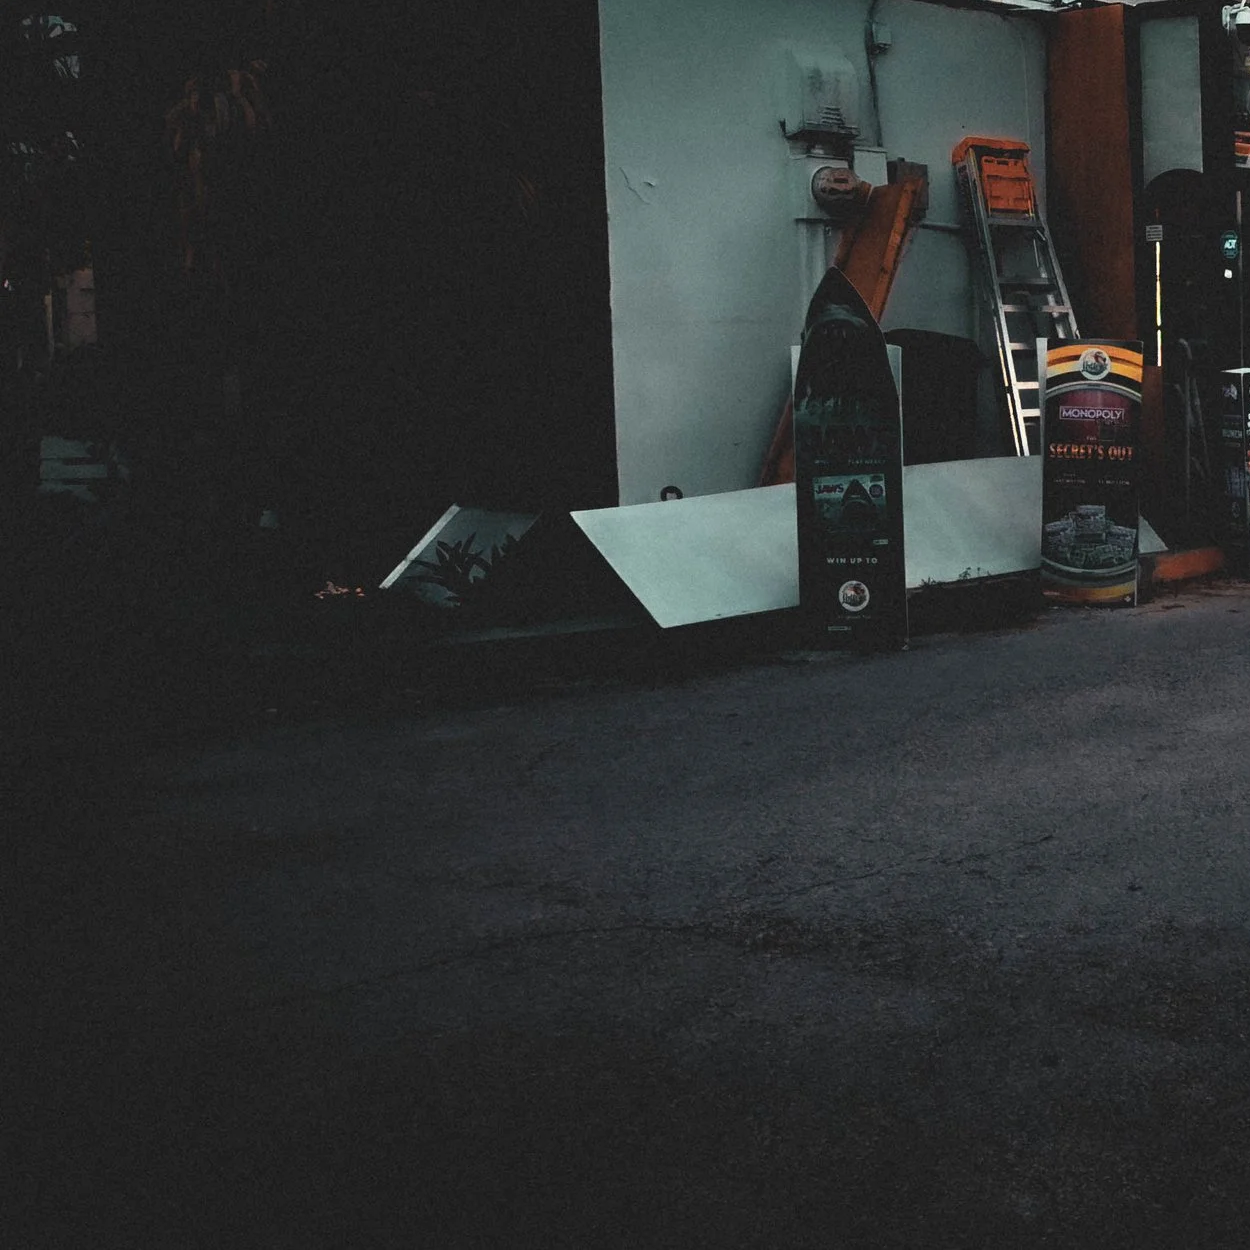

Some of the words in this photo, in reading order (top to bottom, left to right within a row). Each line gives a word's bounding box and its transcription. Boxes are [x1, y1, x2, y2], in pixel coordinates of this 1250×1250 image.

[1062, 408, 1122, 420] MONOPOLY
[1049, 442, 1104, 460] SECRET'S
[1108, 445, 1134, 461] OUT
